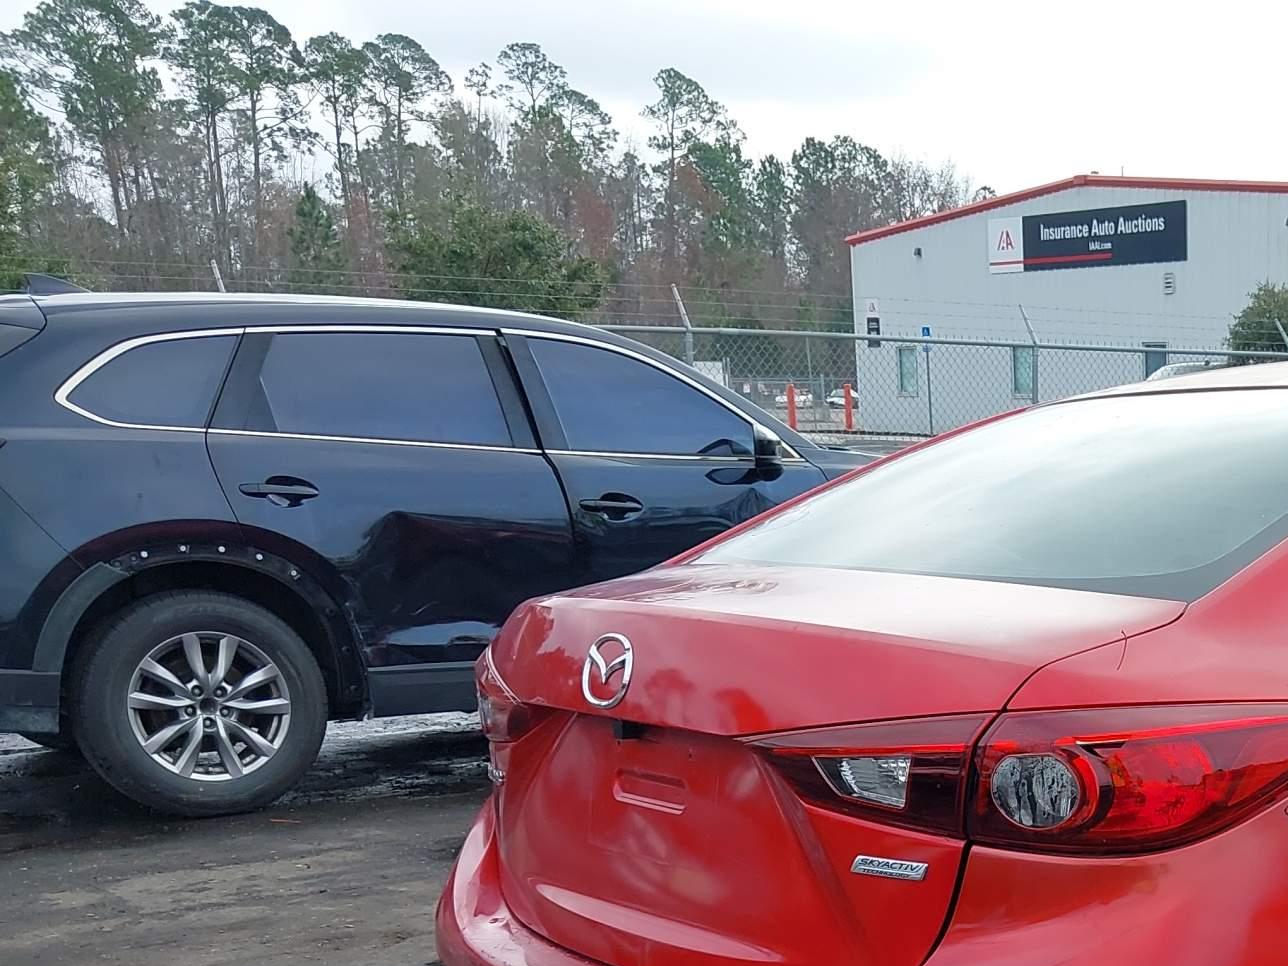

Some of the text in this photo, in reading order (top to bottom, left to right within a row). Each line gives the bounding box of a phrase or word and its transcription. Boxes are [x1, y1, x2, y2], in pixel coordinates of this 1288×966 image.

[1040, 213, 1165, 241] Insurance Auto Auctions
[859, 858, 919, 872] SKYACTIV
